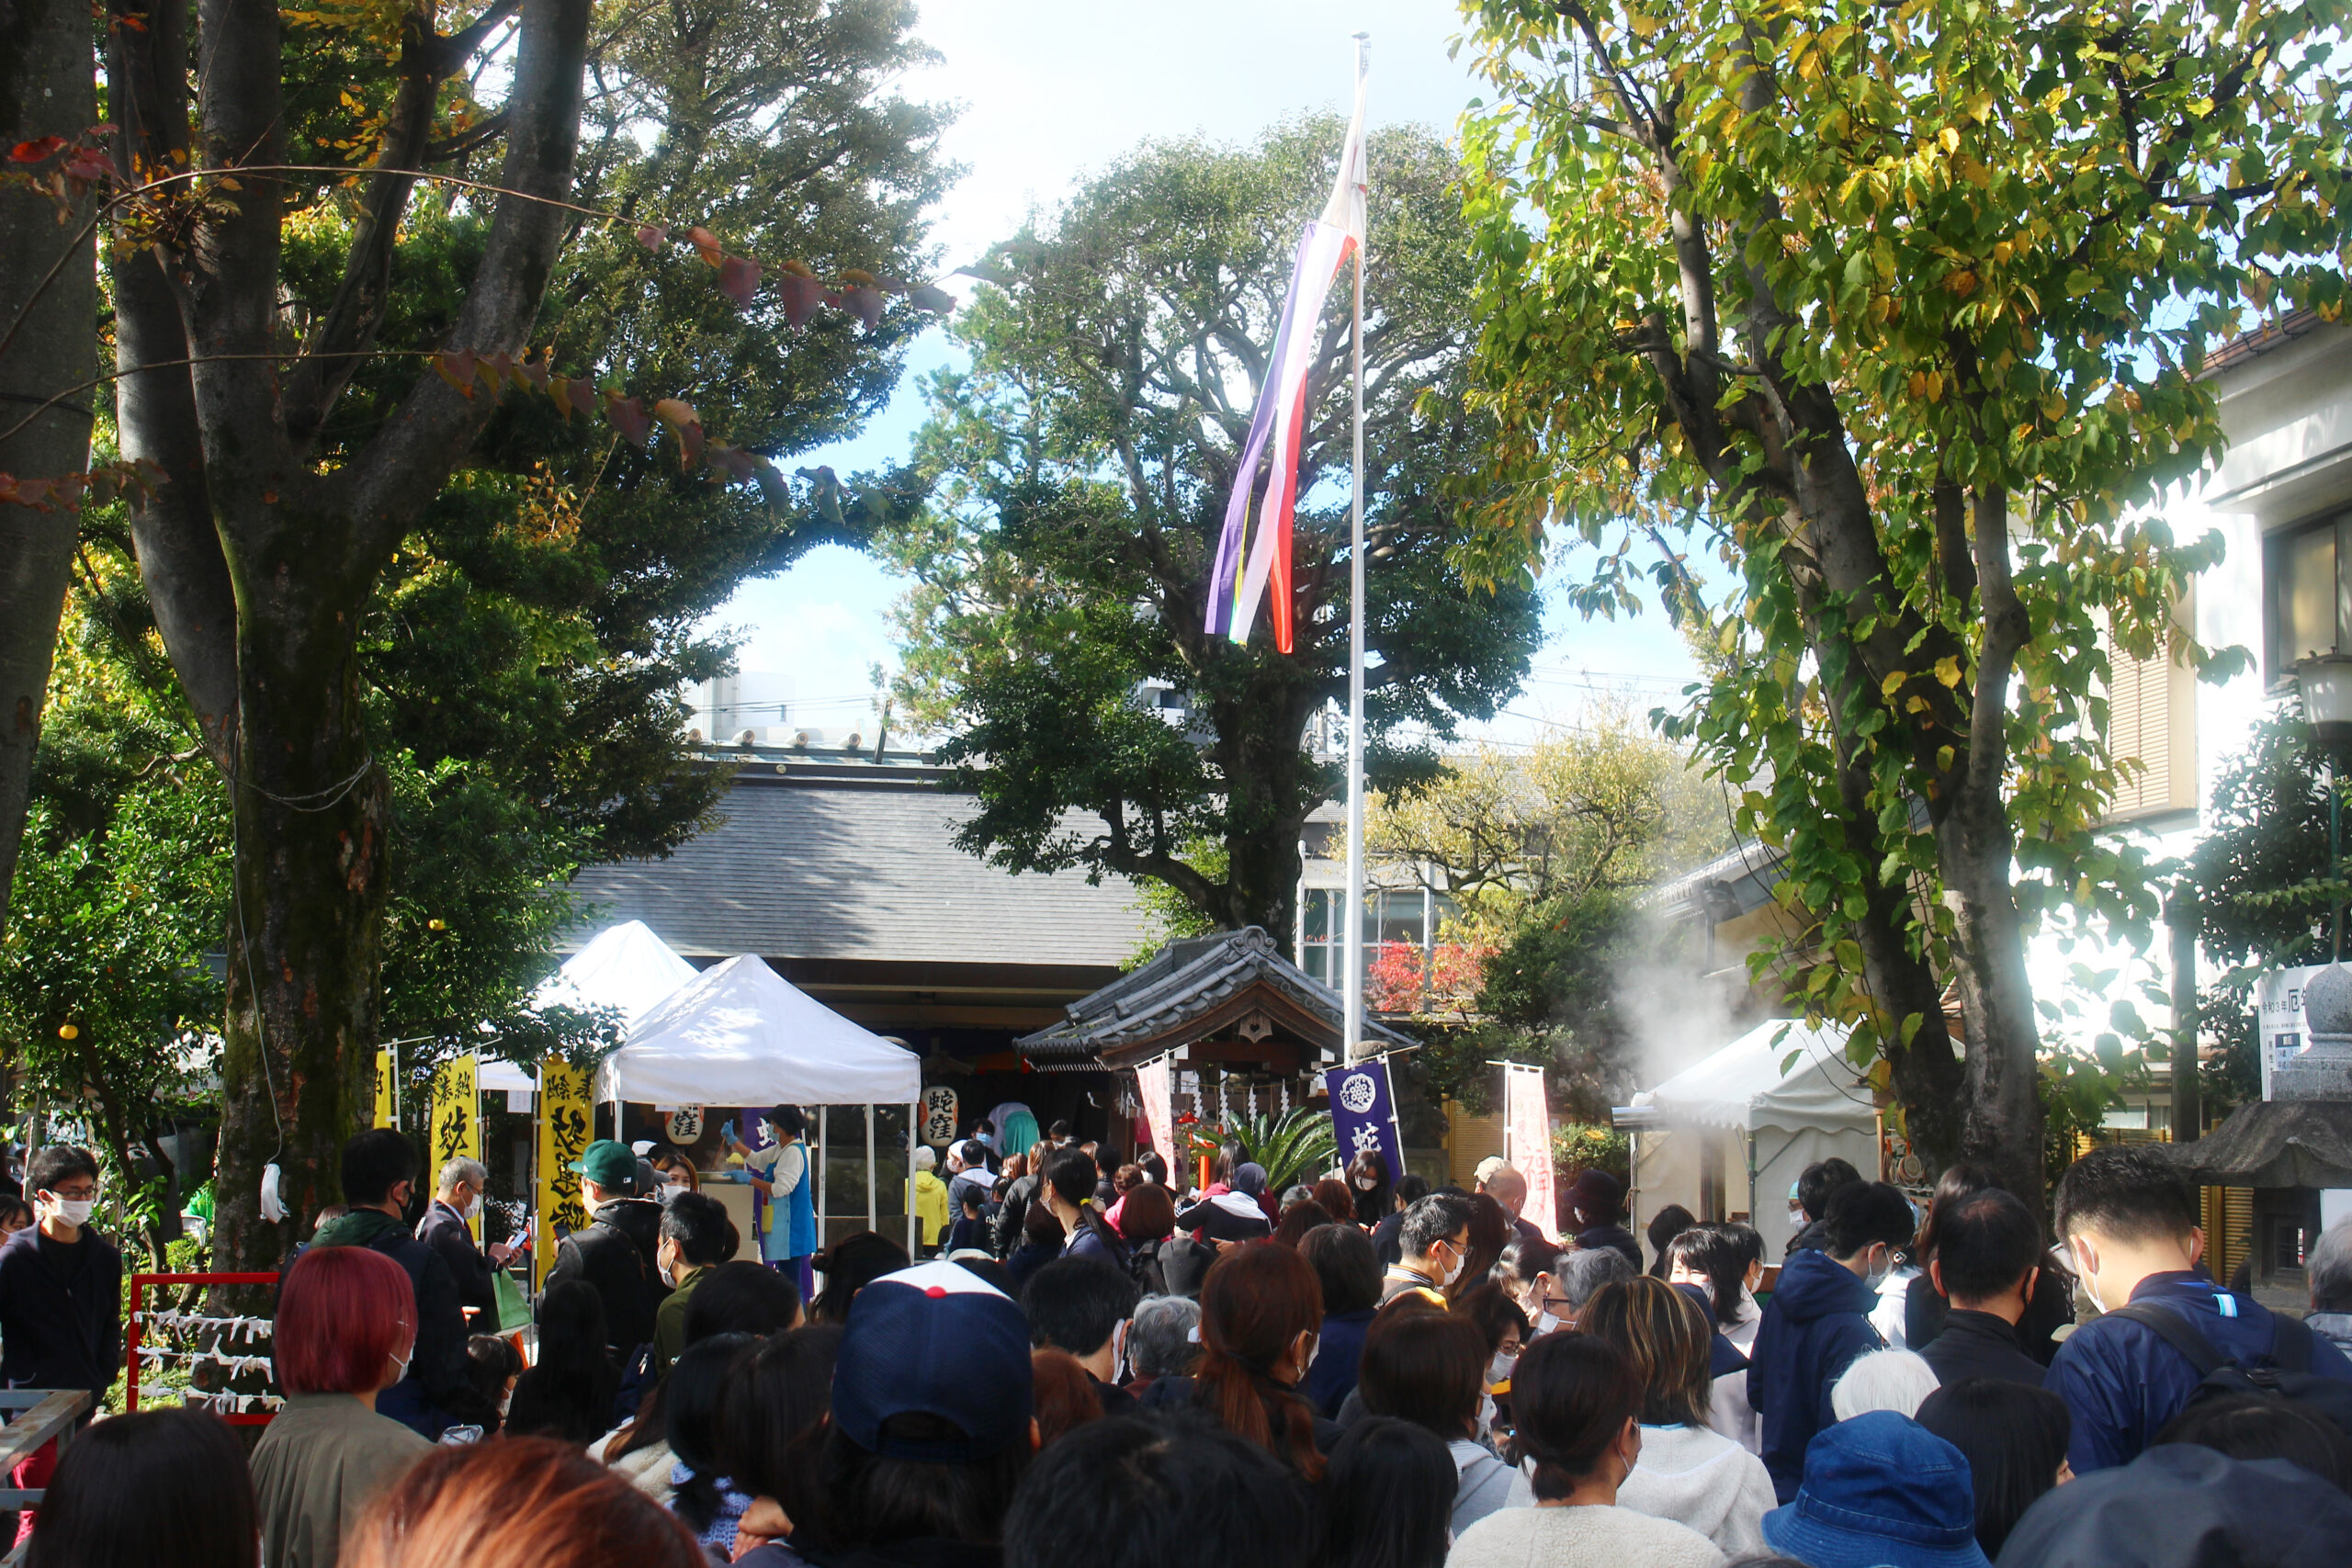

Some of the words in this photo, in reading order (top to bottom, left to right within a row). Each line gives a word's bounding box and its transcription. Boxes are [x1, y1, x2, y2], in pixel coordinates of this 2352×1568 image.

[674, 1106, 698, 1136] 窪
[929, 1089, 954, 1140] 蛇窪
[439, 1105, 469, 1173] 財
[1351, 1122, 1383, 1155] 蛇
